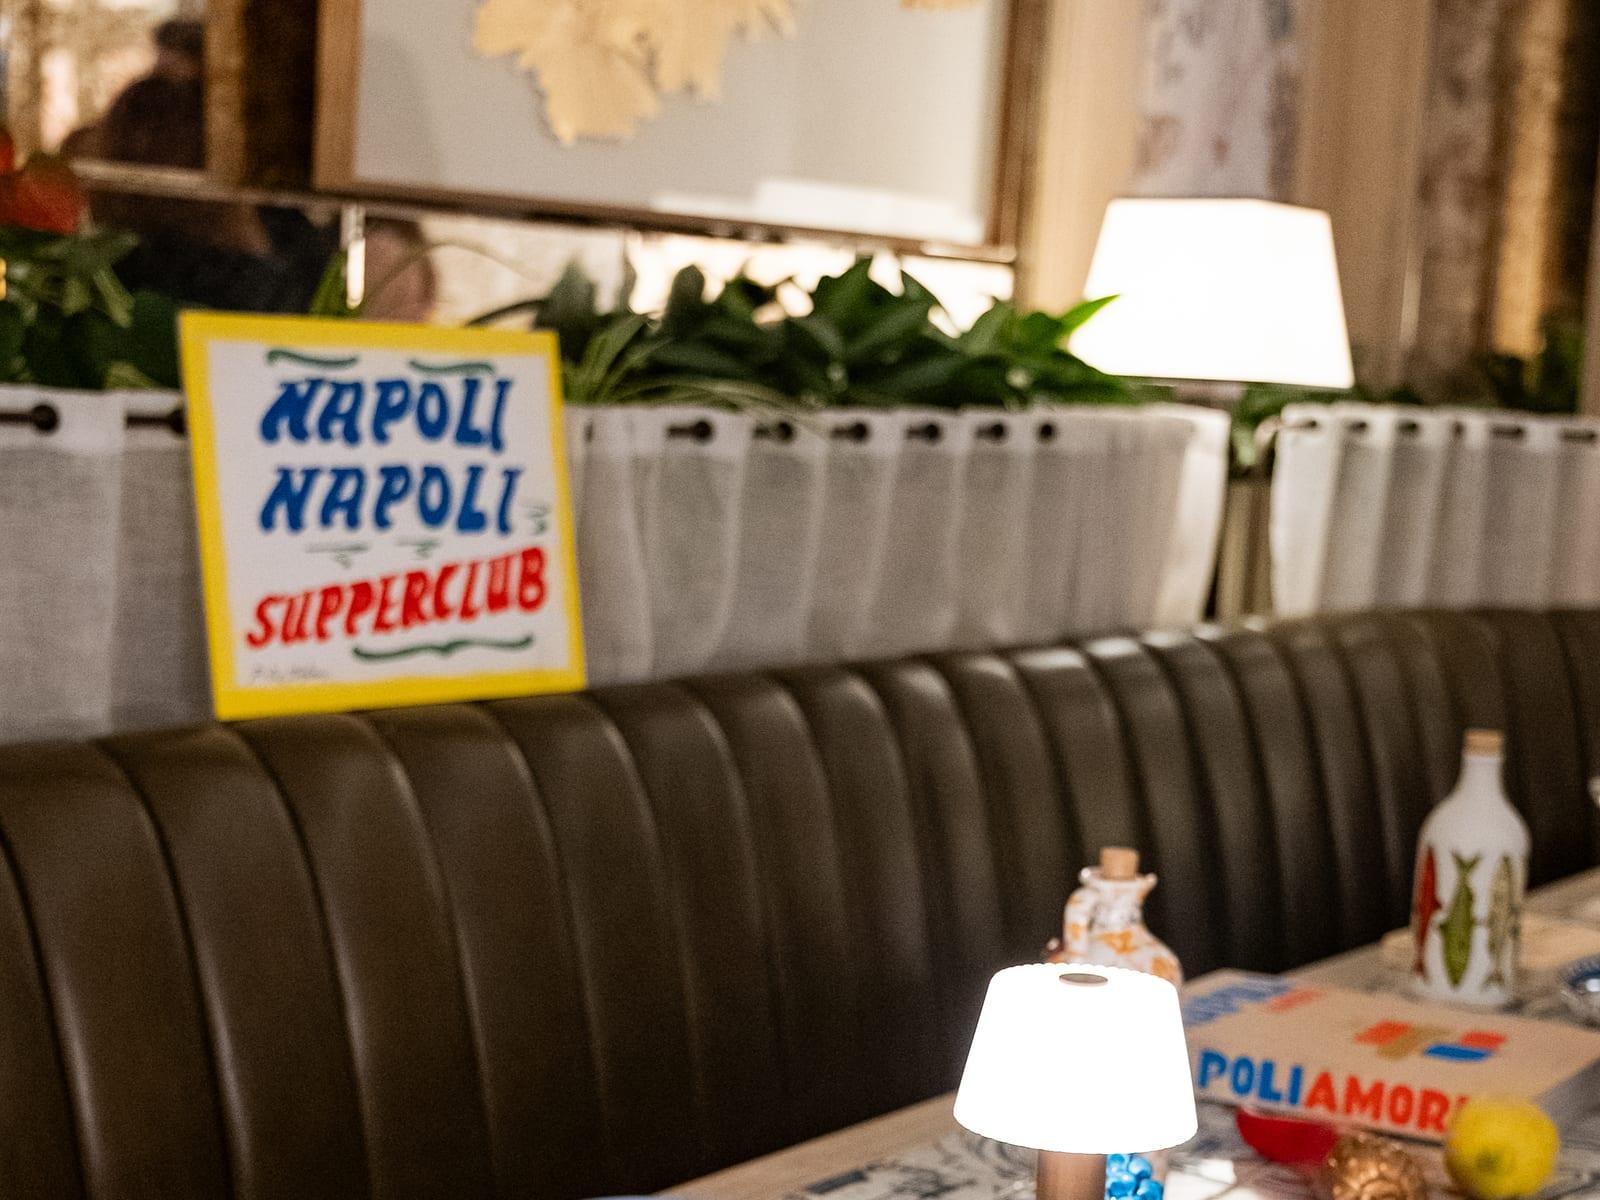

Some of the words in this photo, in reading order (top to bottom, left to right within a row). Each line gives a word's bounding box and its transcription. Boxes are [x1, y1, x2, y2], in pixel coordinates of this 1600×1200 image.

[259, 378, 511, 452] NAPOLI
[259, 464, 523, 535] NAPOLI
[245, 546, 548, 650] SUPPERCLUB
[1197, 1049, 1469, 1133] POLIAMOR
